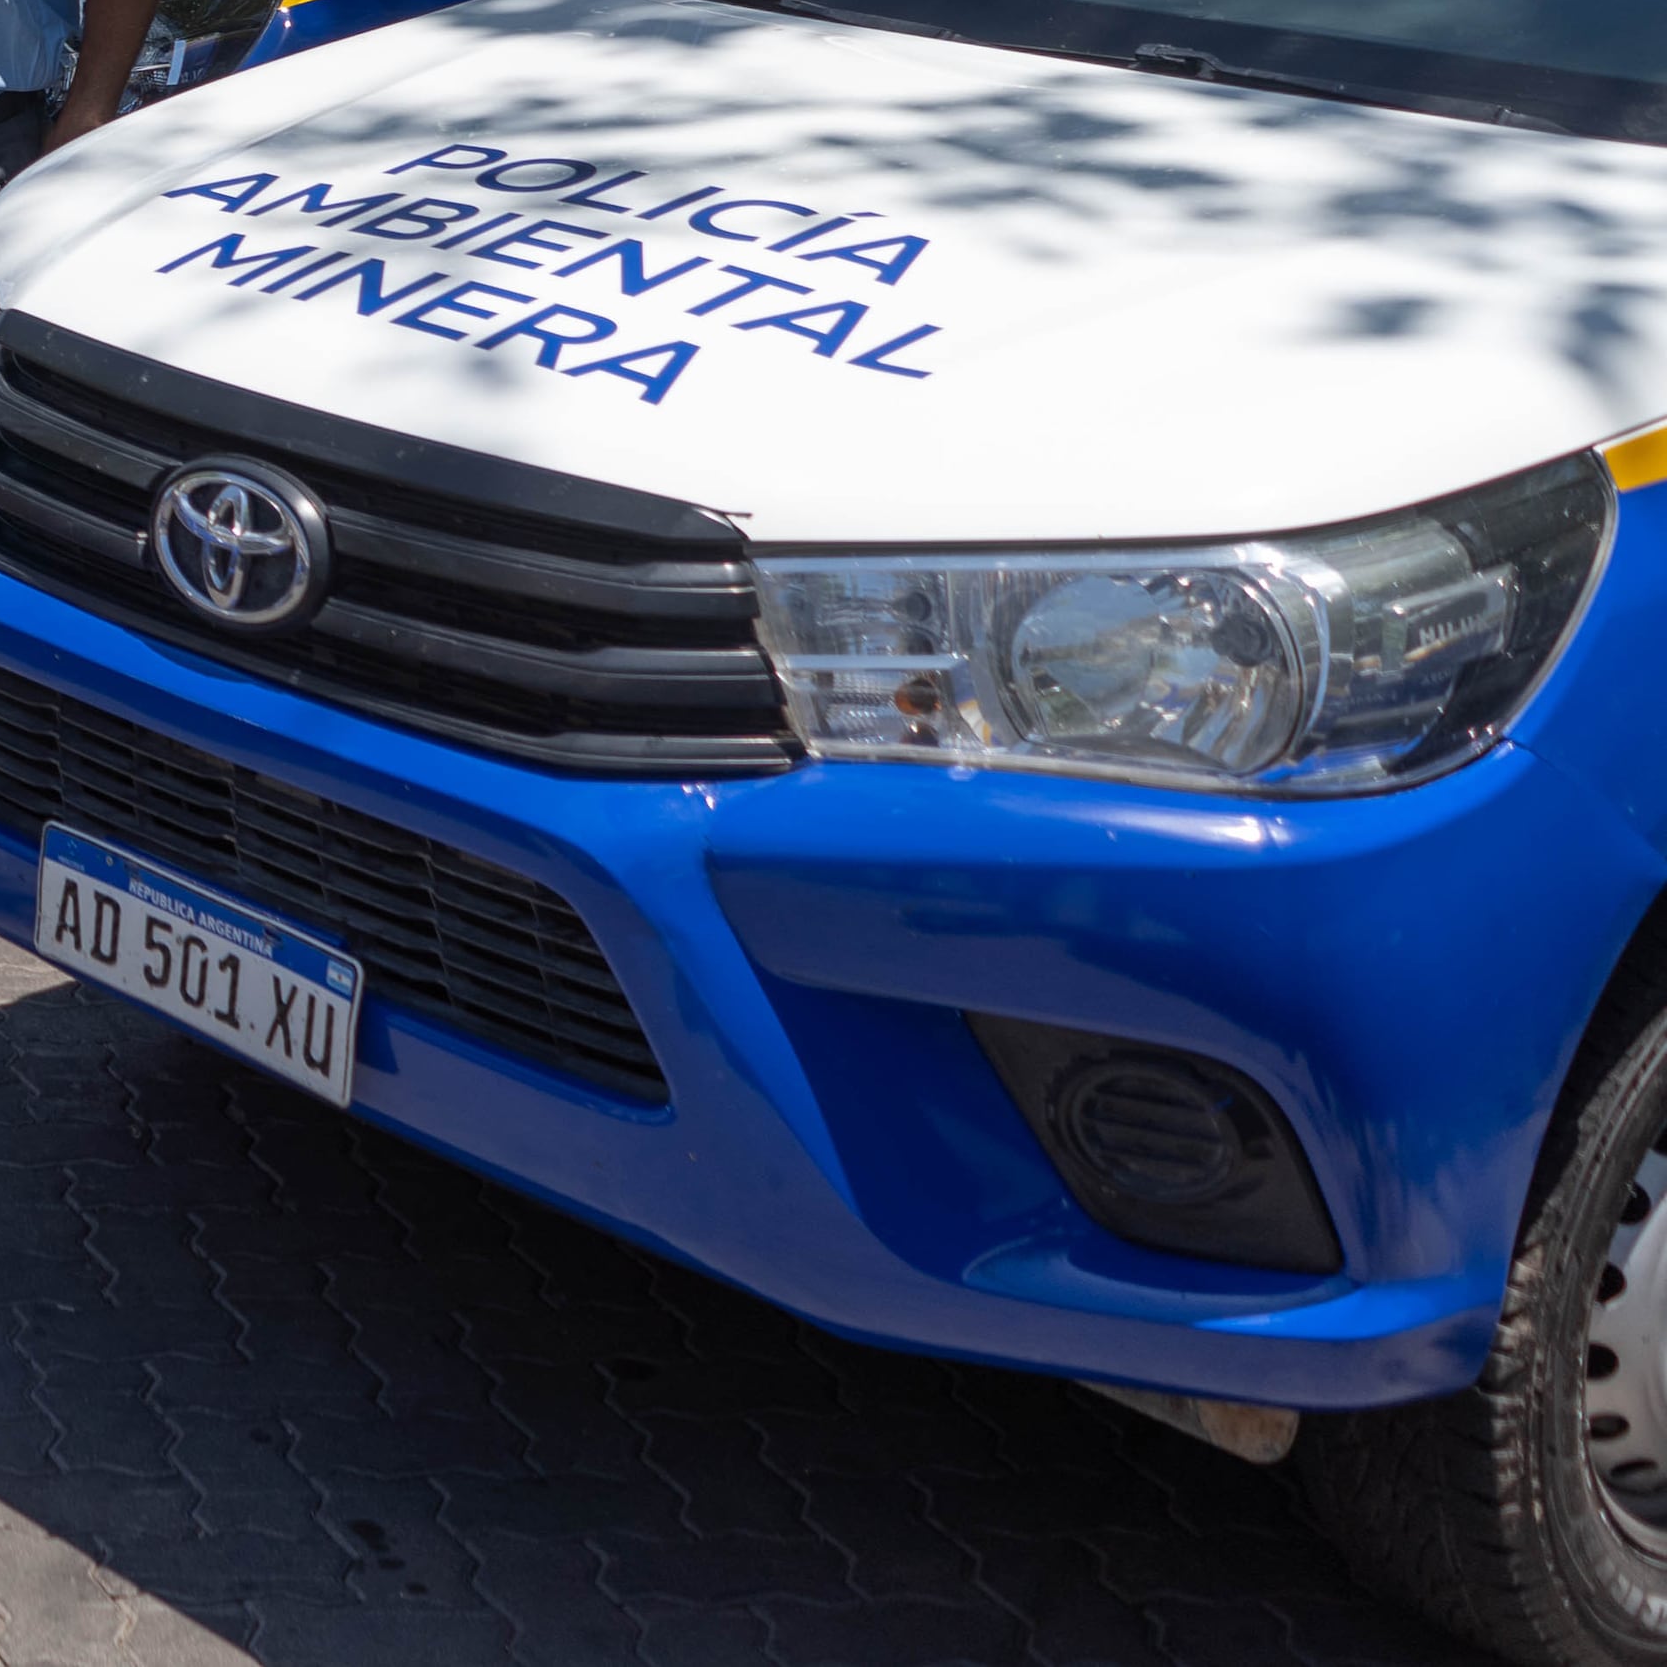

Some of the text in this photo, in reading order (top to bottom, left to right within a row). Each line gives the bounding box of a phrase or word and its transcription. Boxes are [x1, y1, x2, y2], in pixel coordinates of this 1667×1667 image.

[160, 172, 943, 380] AMBIENTAL
[382, 143, 931, 287] POLICÍA
[155, 233, 701, 406] MINERA
[55, 877, 336, 1078] AD 501 XU
[199, 911, 274, 960] ARGENTINA
